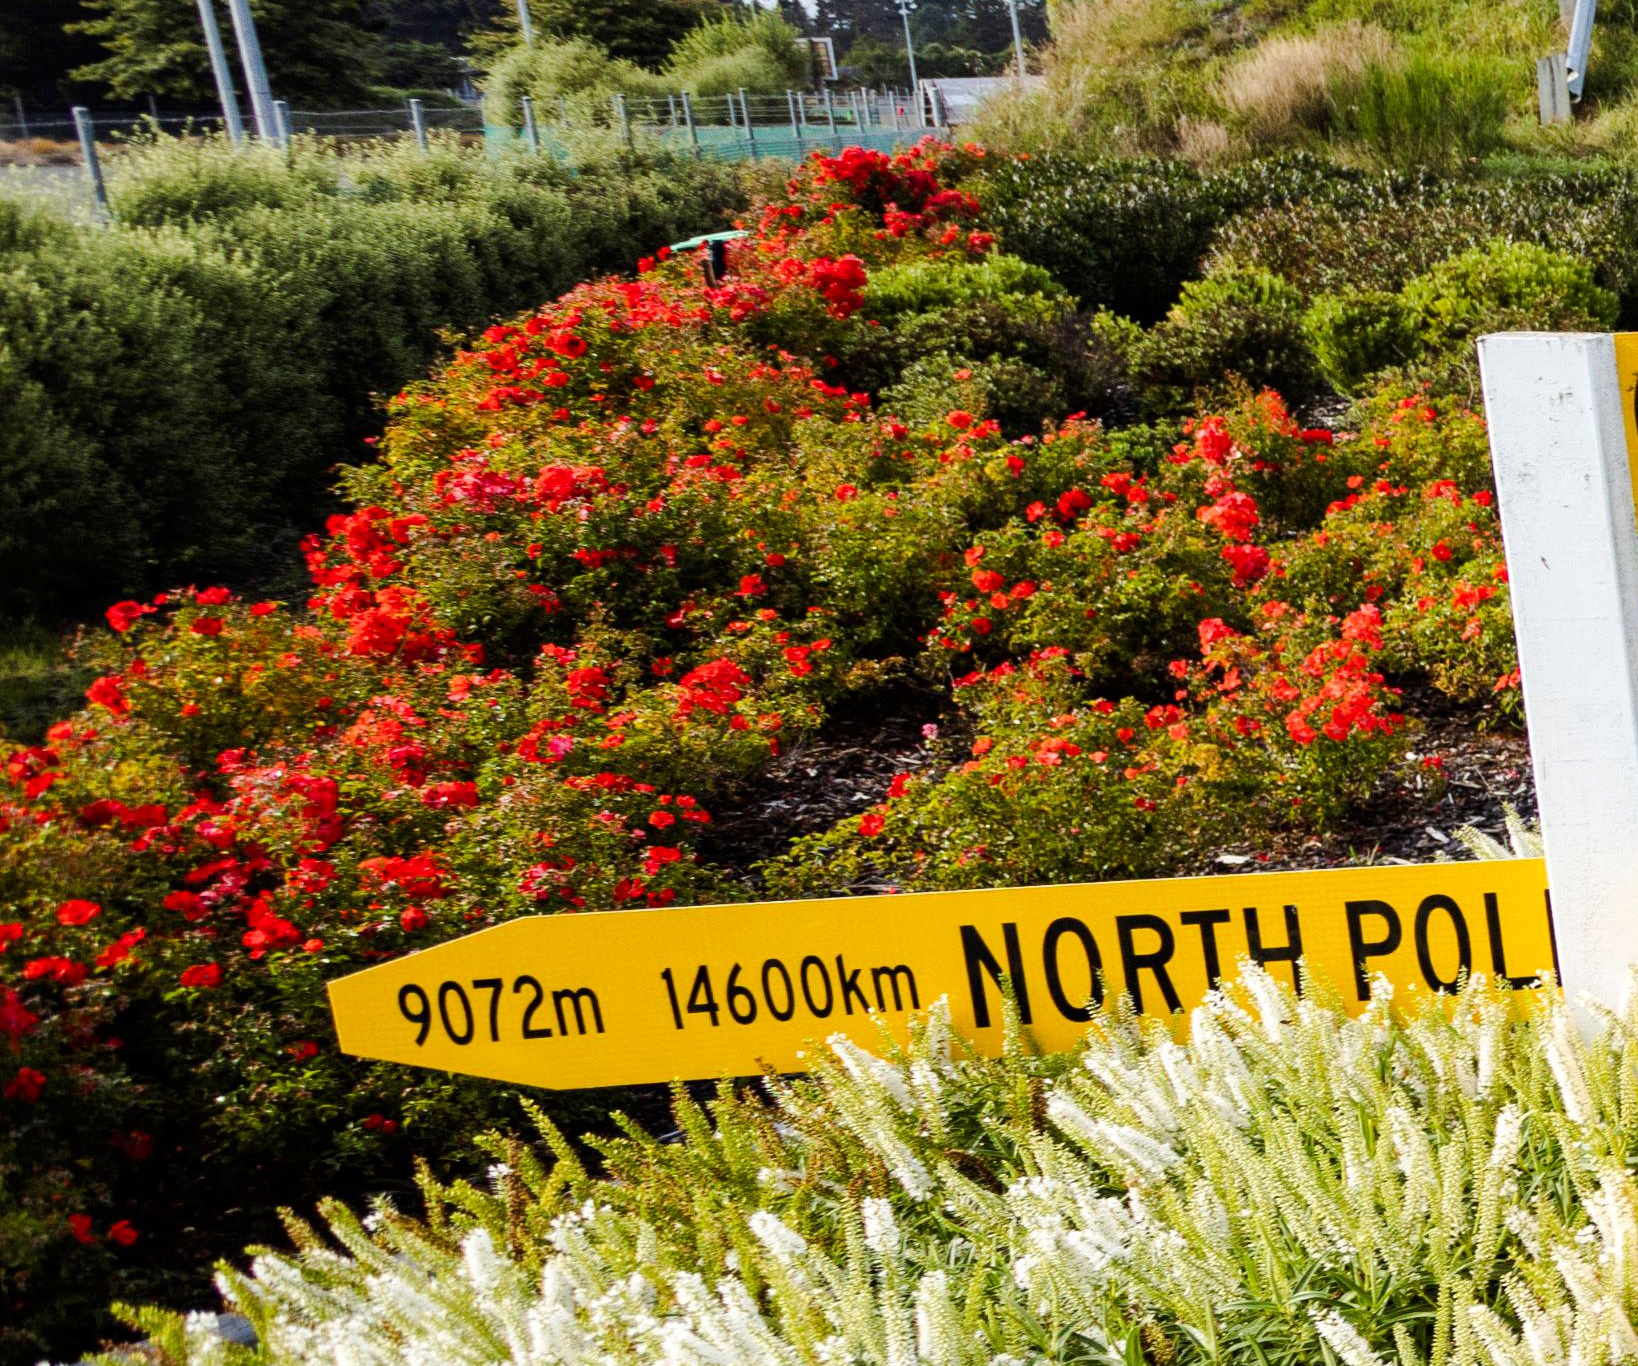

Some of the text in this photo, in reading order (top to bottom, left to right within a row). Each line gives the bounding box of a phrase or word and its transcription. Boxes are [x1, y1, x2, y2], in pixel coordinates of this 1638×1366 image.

[398, 889, 1563, 1047] 9072m 14600km NORTH POL
